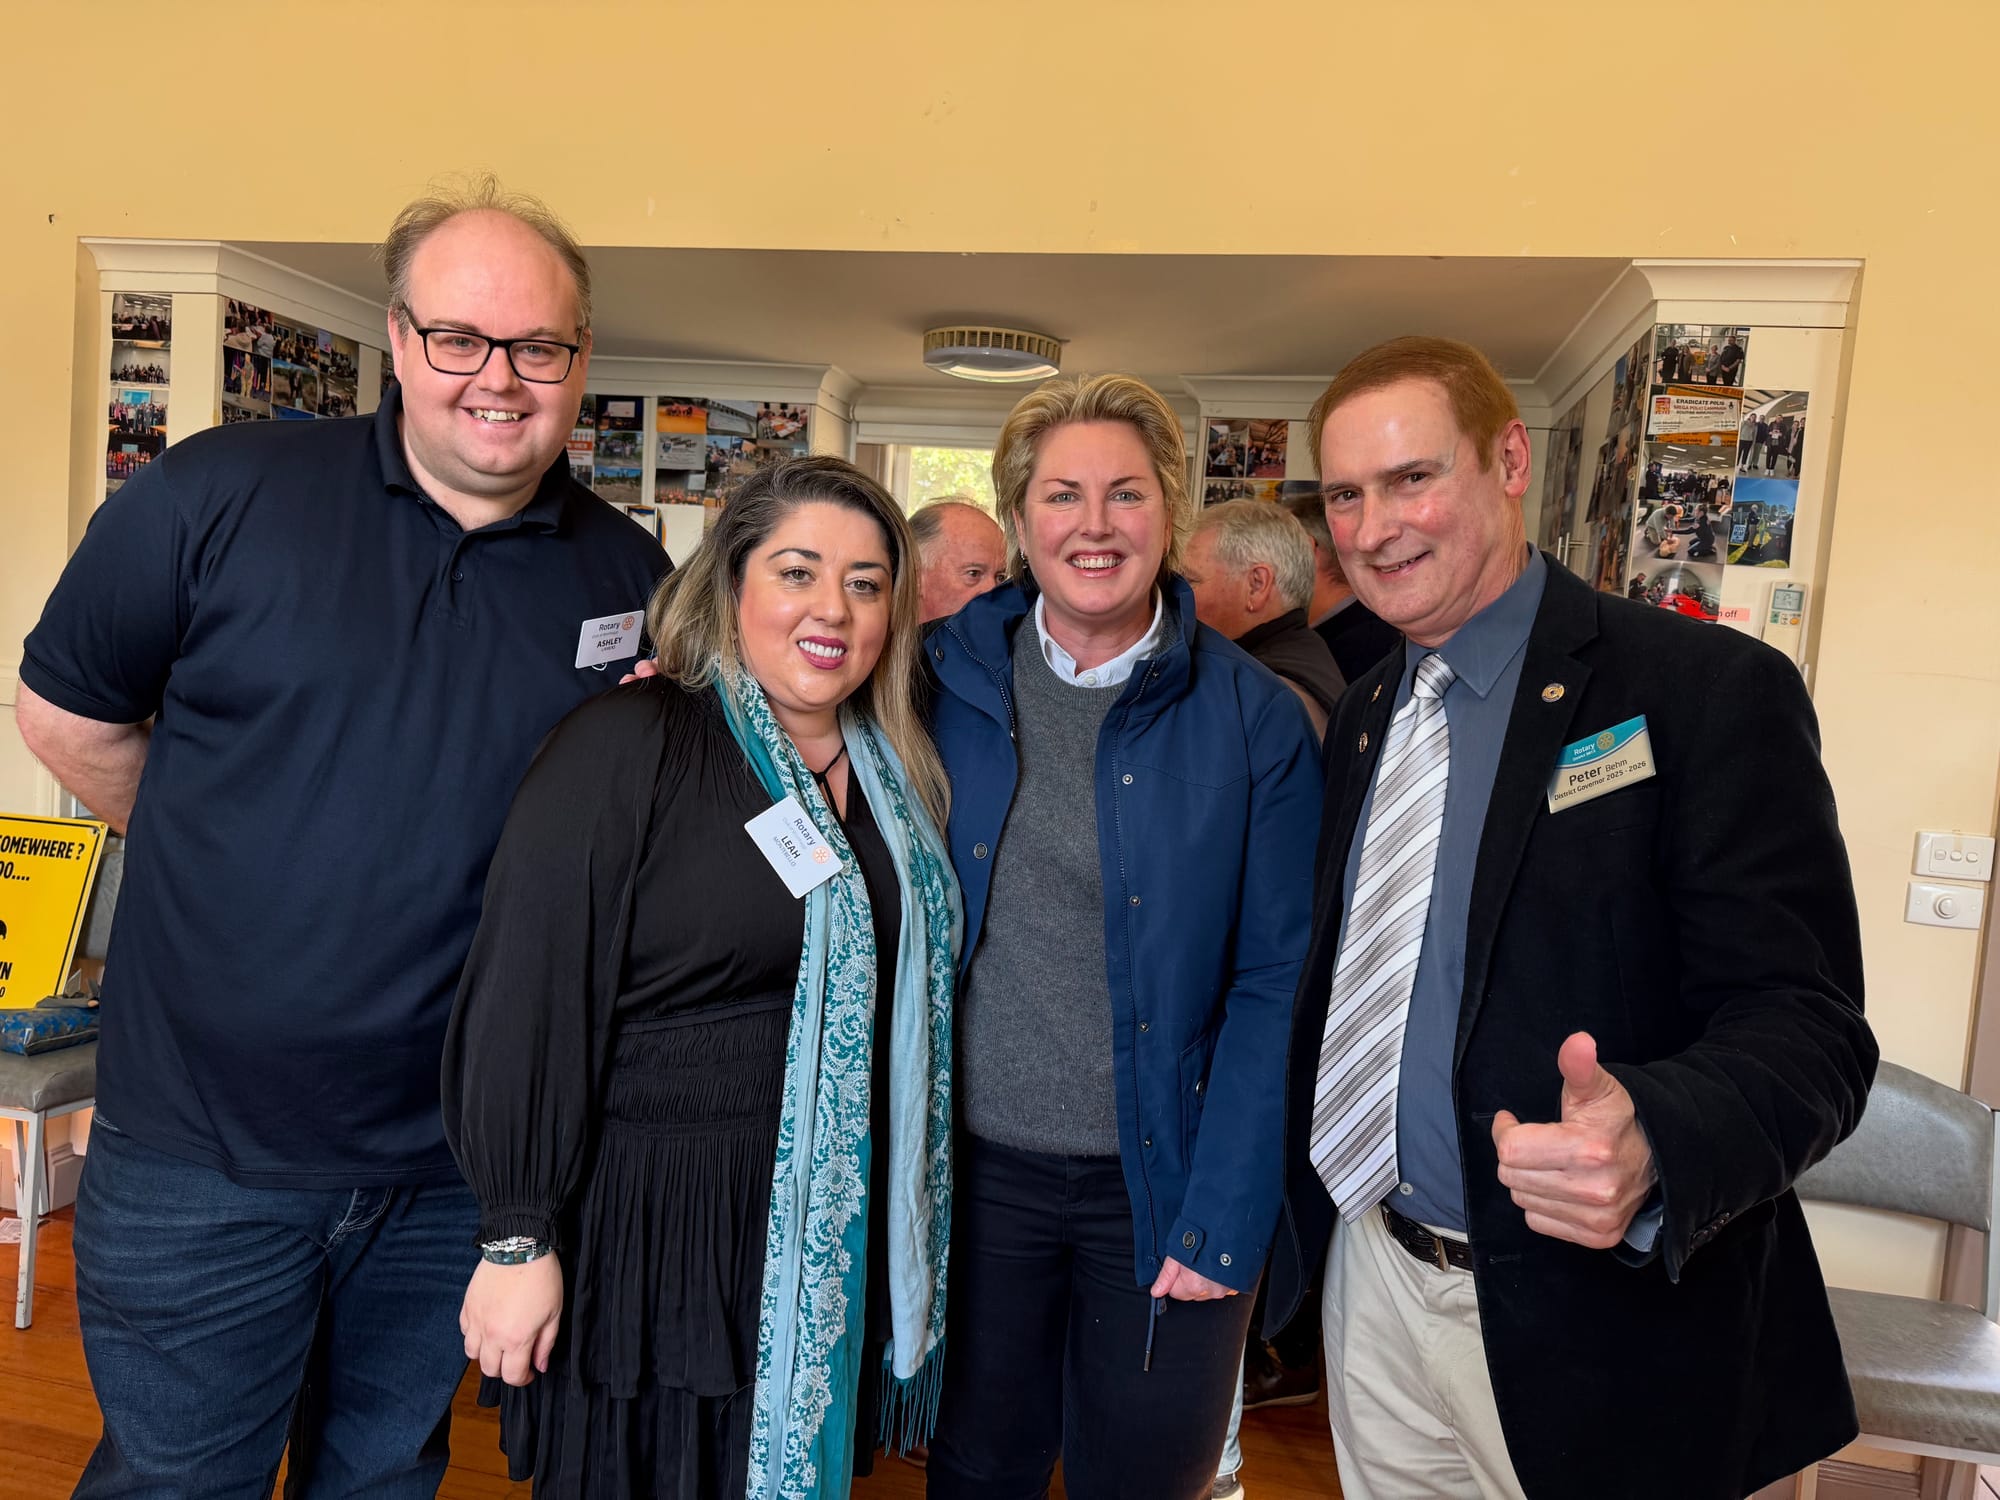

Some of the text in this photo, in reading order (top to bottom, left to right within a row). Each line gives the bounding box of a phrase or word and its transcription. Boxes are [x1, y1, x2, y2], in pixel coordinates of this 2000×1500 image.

[1725, 610, 1738, 618] off
[599, 623, 620, 631] Rotary
[597, 637, 623, 648] ASHLEY
[1573, 743, 1596, 756] Rotary
[1554, 788, 1577, 801] District
[1577, 778, 1605, 791] Governor
[1606, 770, 1624, 781] 2025
[1629, 761, 1647, 772] 2026
[1568, 759, 1628, 786] Peter Behm
[793, 818, 817, 846] Rotary
[0, 835, 75, 860] OMEWHERE
[780, 835, 801, 859] LEAH
